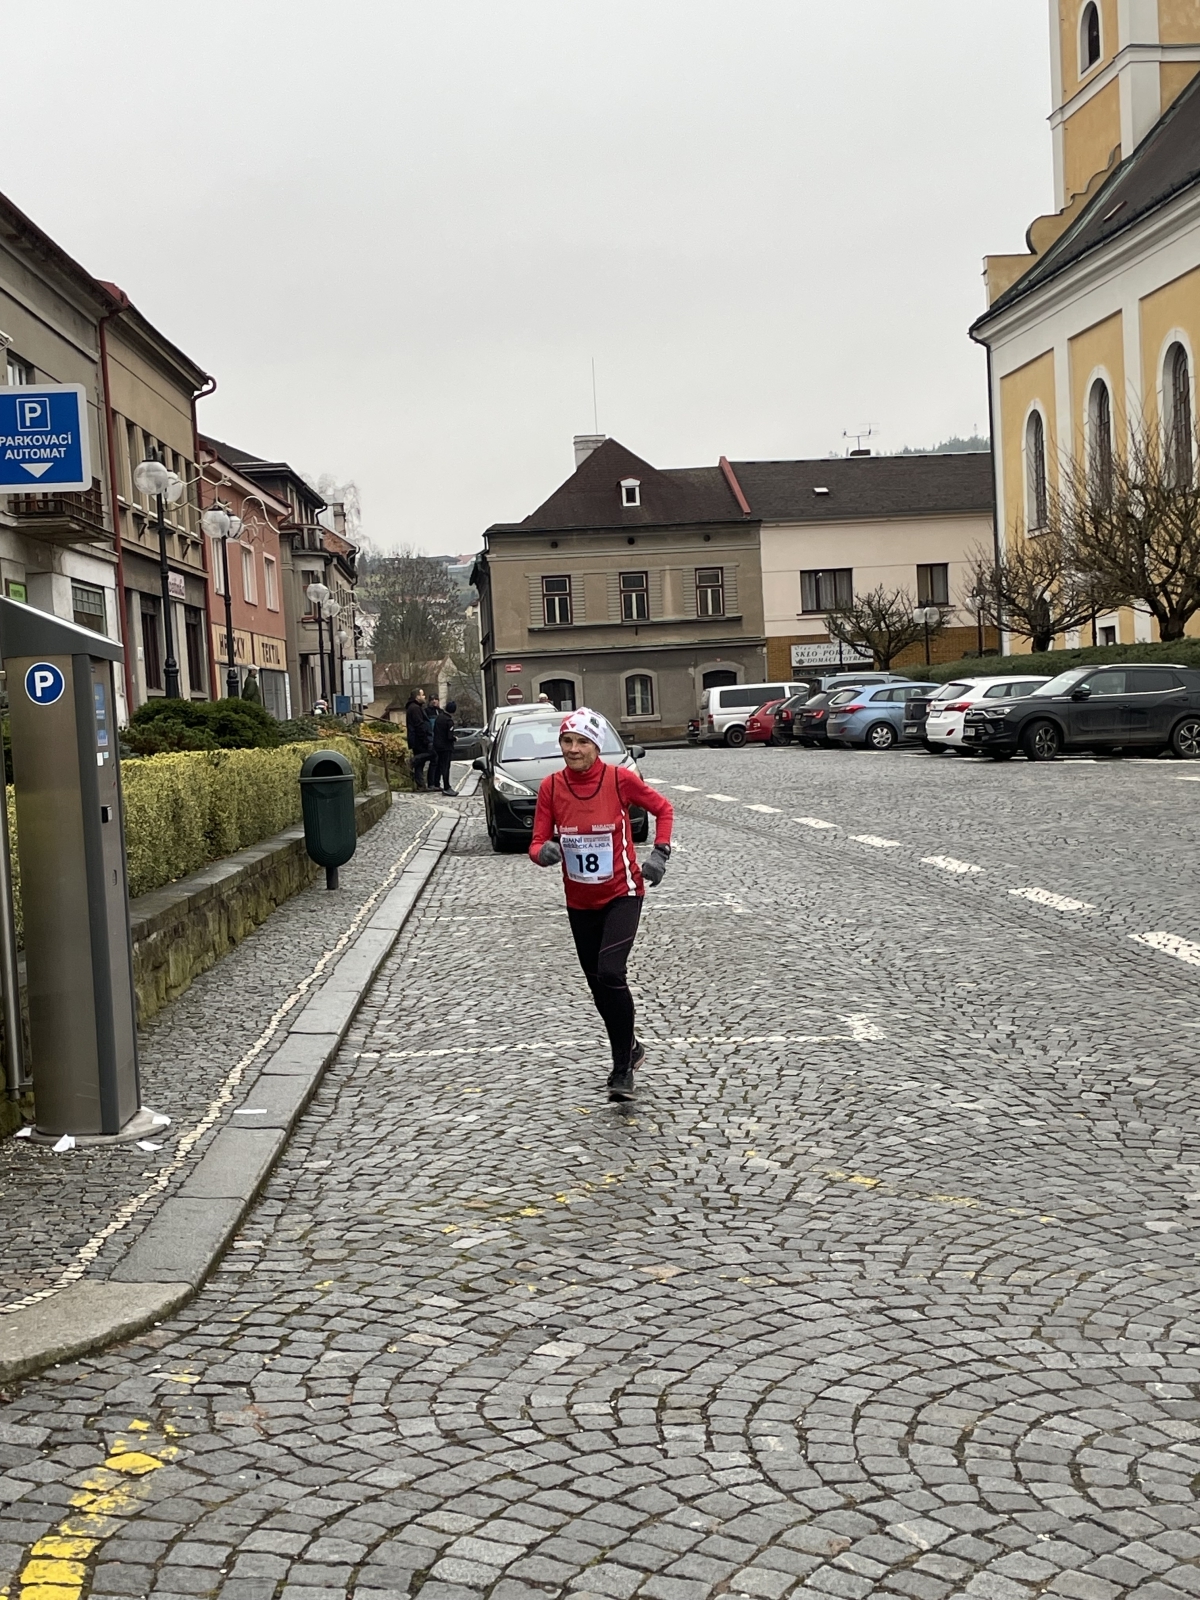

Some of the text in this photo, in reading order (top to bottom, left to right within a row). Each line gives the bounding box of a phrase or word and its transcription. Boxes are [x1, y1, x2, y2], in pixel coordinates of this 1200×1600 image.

[24, 402, 42, 427] P
[0, 432, 72, 447] PARKOVACÍ
[4, 447, 67, 460] AUTOMAT
[795, 650, 818, 658] SKLO
[807, 656, 836, 664] DOMÁCÍ
[34, 671, 54, 697] P
[576, 853, 599, 873] 18
